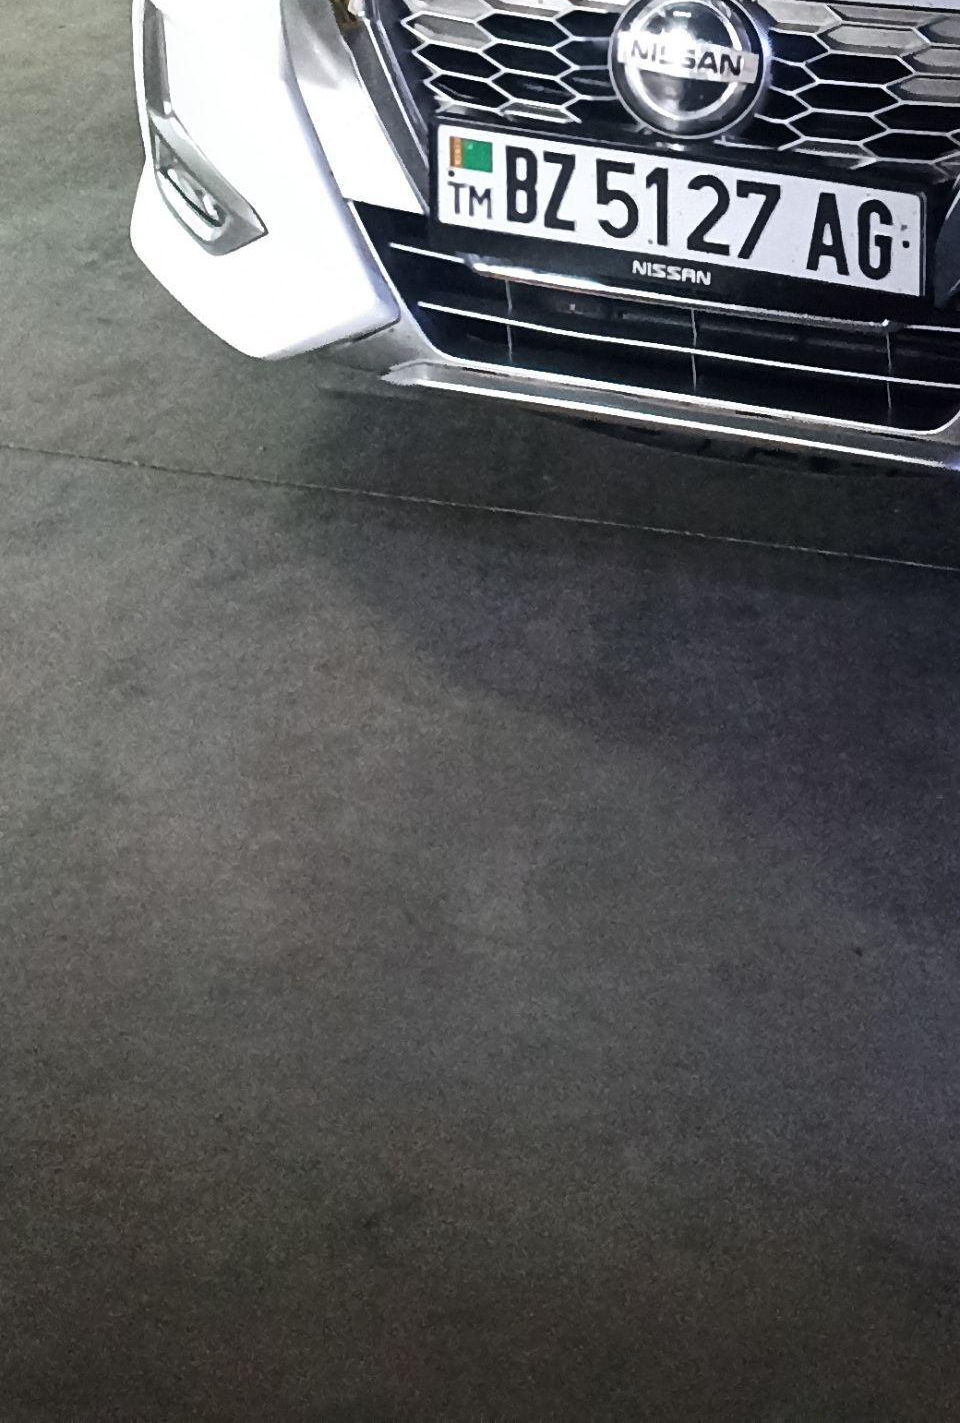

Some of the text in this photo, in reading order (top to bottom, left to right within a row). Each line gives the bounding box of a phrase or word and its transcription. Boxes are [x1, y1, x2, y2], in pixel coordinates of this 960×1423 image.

[631, 39, 742, 76] NISSAN
[447, 180, 493, 219] TM
[505, 145, 893, 281] BZ 5127 AG
[632, 260, 712, 286] NISSAN
